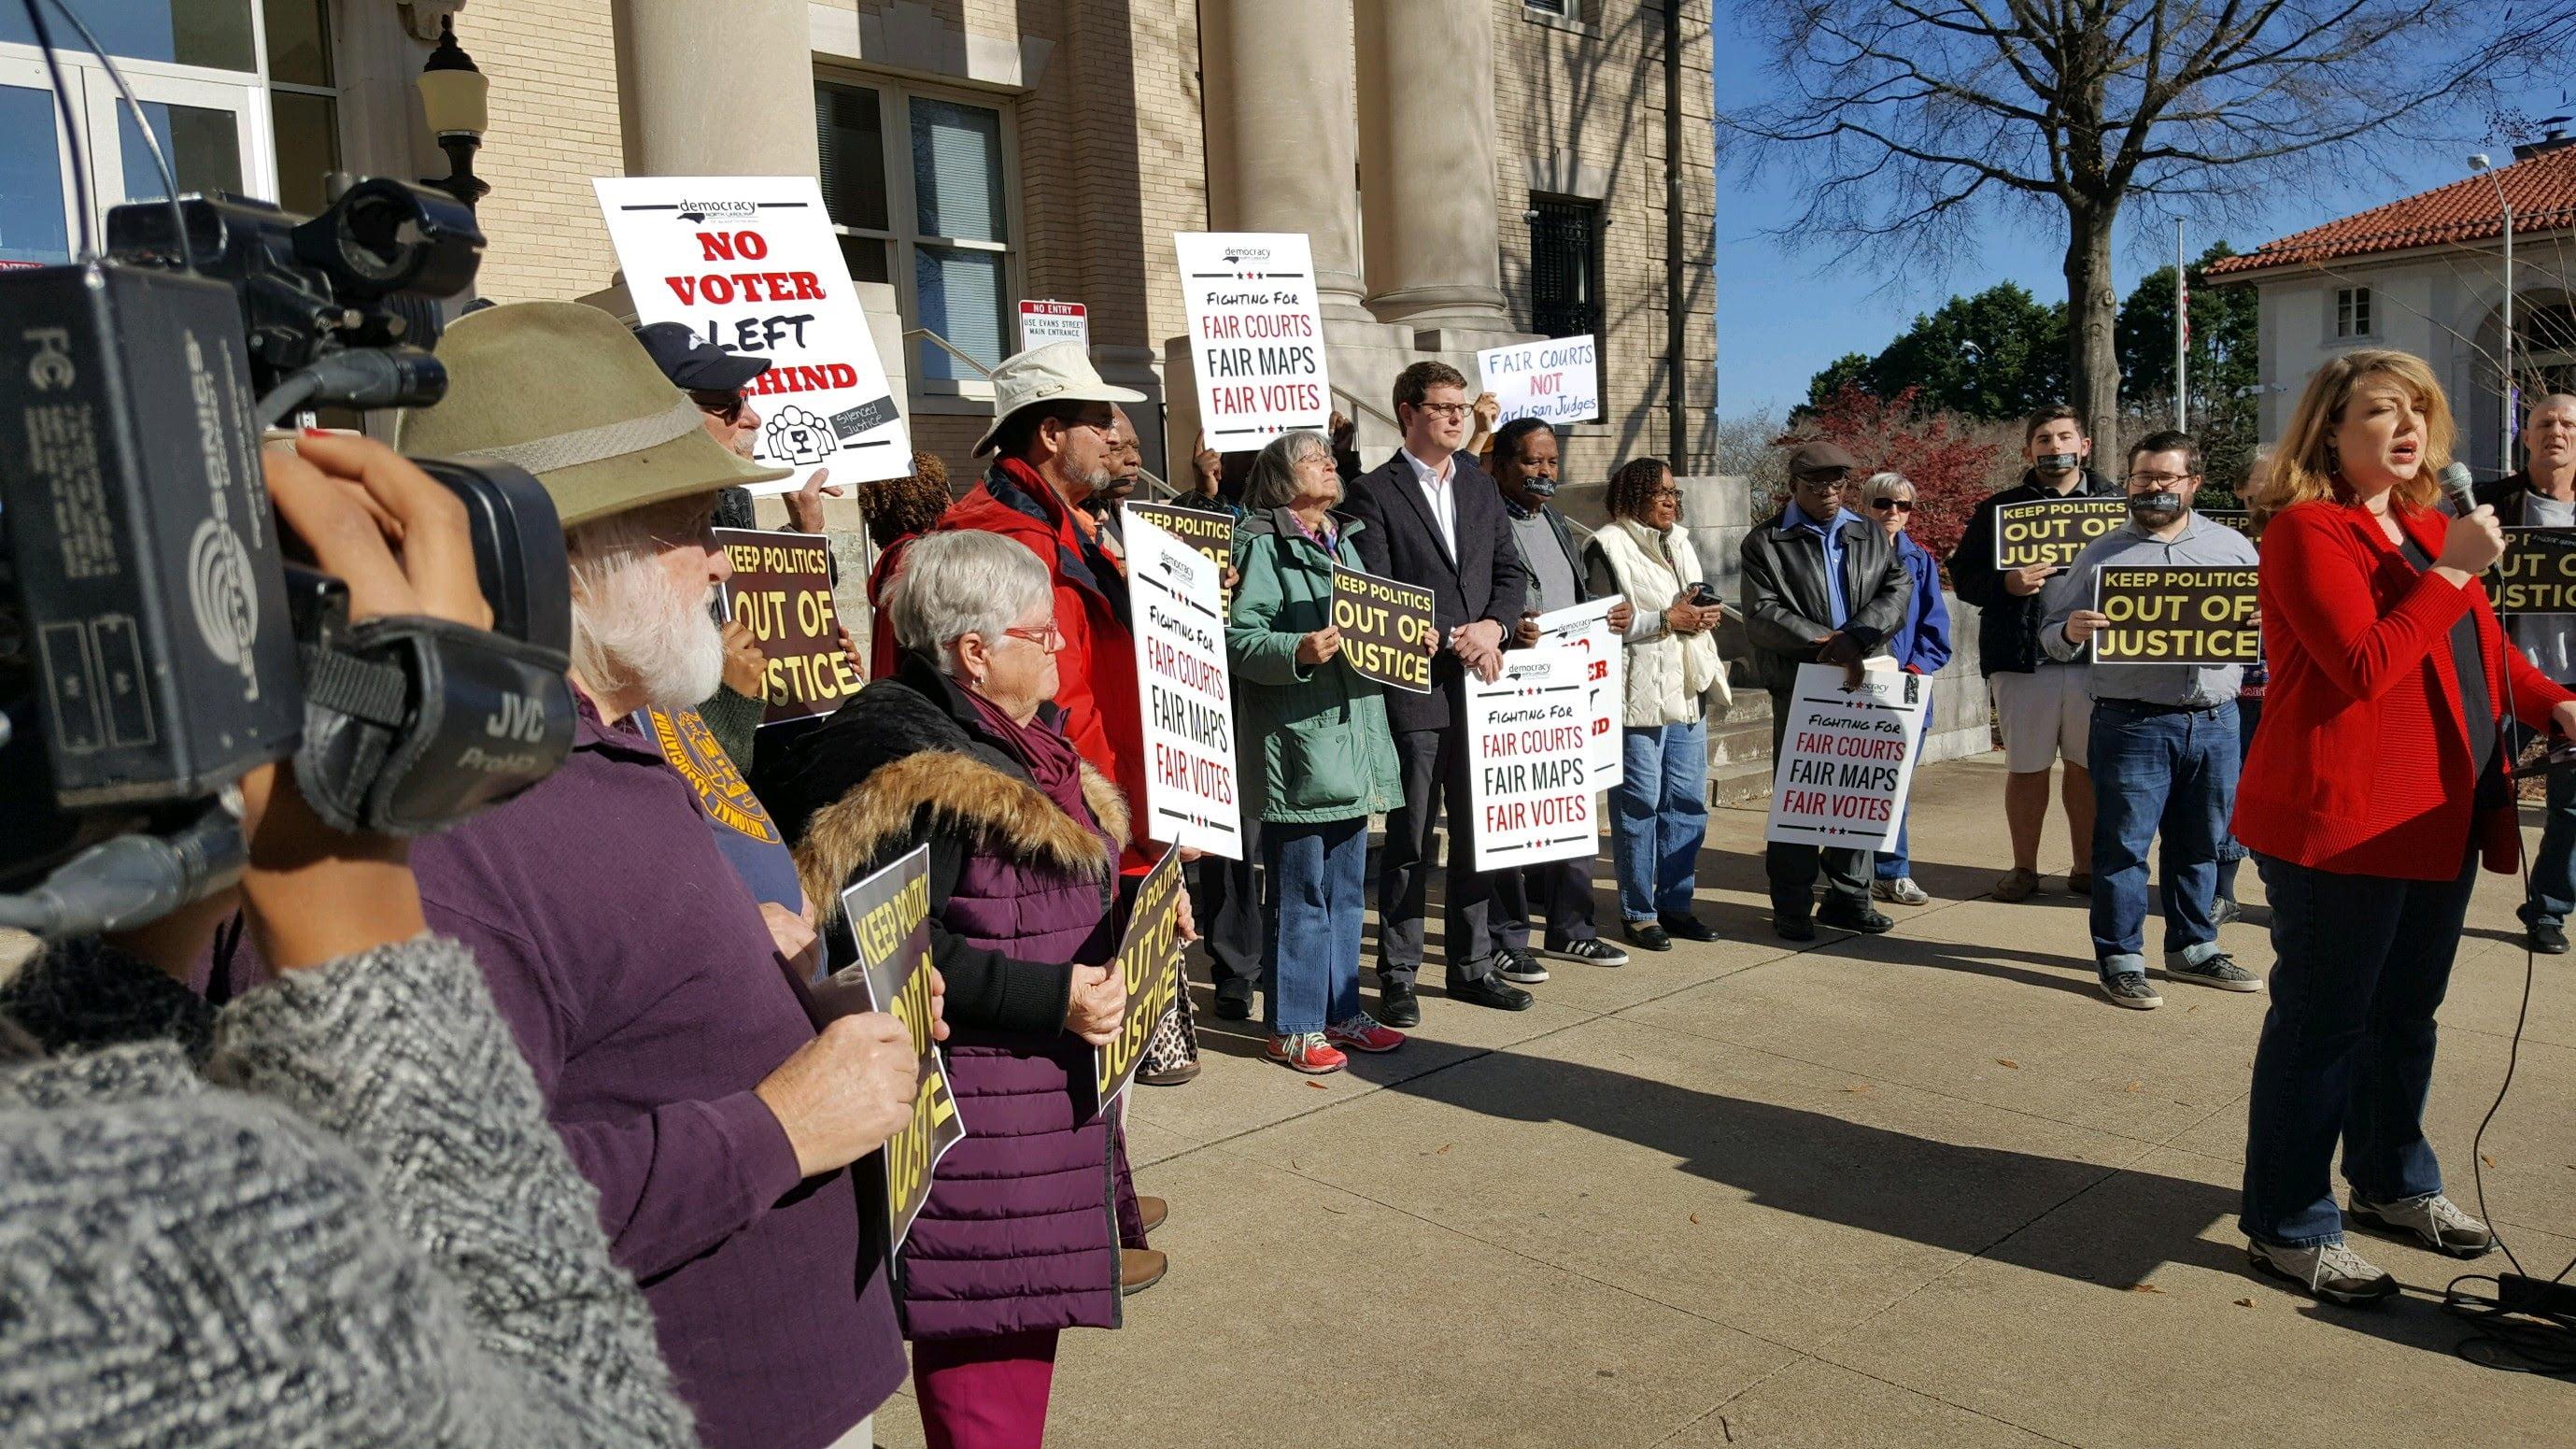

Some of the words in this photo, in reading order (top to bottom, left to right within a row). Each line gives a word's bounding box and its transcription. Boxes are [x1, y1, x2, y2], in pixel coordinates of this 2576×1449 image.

[680, 199, 757, 213] democracy
[696, 230, 768, 261] NO
[1225, 247, 1270, 258] democracy
[664, 272, 827, 305] VOTER
[1207, 291, 1268, 305] FIGHTING
[1273, 291, 1299, 305] FOR
[1025, 319, 1037, 327] USE
[1040, 320, 1059, 328] EVANS
[1062, 320, 1083, 329] STREET
[1033, 304, 1045, 313] NO
[1048, 305, 1072, 315] ENTRY
[709, 314, 814, 352] LEFT
[1048, 329, 1080, 337] ENTRANCE
[1202, 316, 1241, 339] FAIR
[1245, 314, 1312, 338] COURTS
[1207, 348, 1254, 377] FAIR
[1258, 347, 1316, 376] MAPS
[1489, 351, 1533, 374] FAIR
[1539, 345, 1592, 369] COURTS
[743, 362, 857, 397] HIND
[1530, 373, 1564, 397] NOT
[836, 403, 878, 424] Silenced
[1212, 386, 1256, 415] FAIR
[1260, 384, 1320, 412] VOTES
[1555, 395, 1596, 418] Judges
[842, 414, 883, 434] Justice
[2003, 504, 2045, 519] KEEP
[2050, 503, 2127, 515] POLITICS
[1175, 517, 1231, 540] POLITICS
[2004, 519, 2072, 541] OUT
[724, 545, 760, 573] KEEP
[763, 547, 827, 575] POLITICS
[1161, 549, 1194, 580] democracy
[1334, 572, 1367, 595] KEEP
[1370, 583, 1432, 612] POLITICS
[2105, 573, 2158, 587] KEEP
[2165, 572, 2258, 587] POLITICS
[735, 590, 786, 641] OUT
[797, 590, 834, 638] OF
[1335, 599, 1389, 636] OUT
[1397, 614, 1431, 646] OF
[2104, 595, 2188, 622] OUT
[2201, 595, 2258, 622] OF
[1150, 605, 1195, 641] FIGHTING
[1196, 629, 1214, 654] FOR
[1558, 618, 1592, 632] democracy
[2098, 630, 2258, 657] JUSTICE
[1148, 635, 1177, 680] FAIR
[1179, 650, 1224, 702] COURTS
[1509, 662, 1550, 674] democracy
[486, 691, 545, 742] JVC
[1152, 684, 1187, 737] FAIR
[1189, 700, 1227, 753] MAPS
[1488, 709, 1546, 724] FIGHTING
[1550, 705, 1573, 717] FOR
[1808, 714, 1870, 730] FIGHTING
[1875, 720, 1902, 734] FOR
[1482, 733, 1517, 759] FAIR
[1522, 726, 1583, 754] COURTS
[1795, 732, 1833, 755] FAIR
[1836, 736, 1906, 761] COURTS
[1156, 743, 1189, 792] FAIR
[1191, 754, 1231, 805] VOTES
[1484, 765, 1526, 796] FAIR
[1532, 758, 1584, 790] MAPS
[1789, 759, 1834, 787] FAIR
[1838, 763, 1899, 792] MAPS
[1486, 803, 1526, 832] FAIR
[1531, 795, 1586, 827] VOTES
[1783, 789, 1827, 816] FAIR
[1833, 794, 1892, 822] VOTES
[856, 902, 899, 970] KEEP
[1158, 892, 1181, 958] OF
[1099, 951, 1182, 1093] JUSTICE
